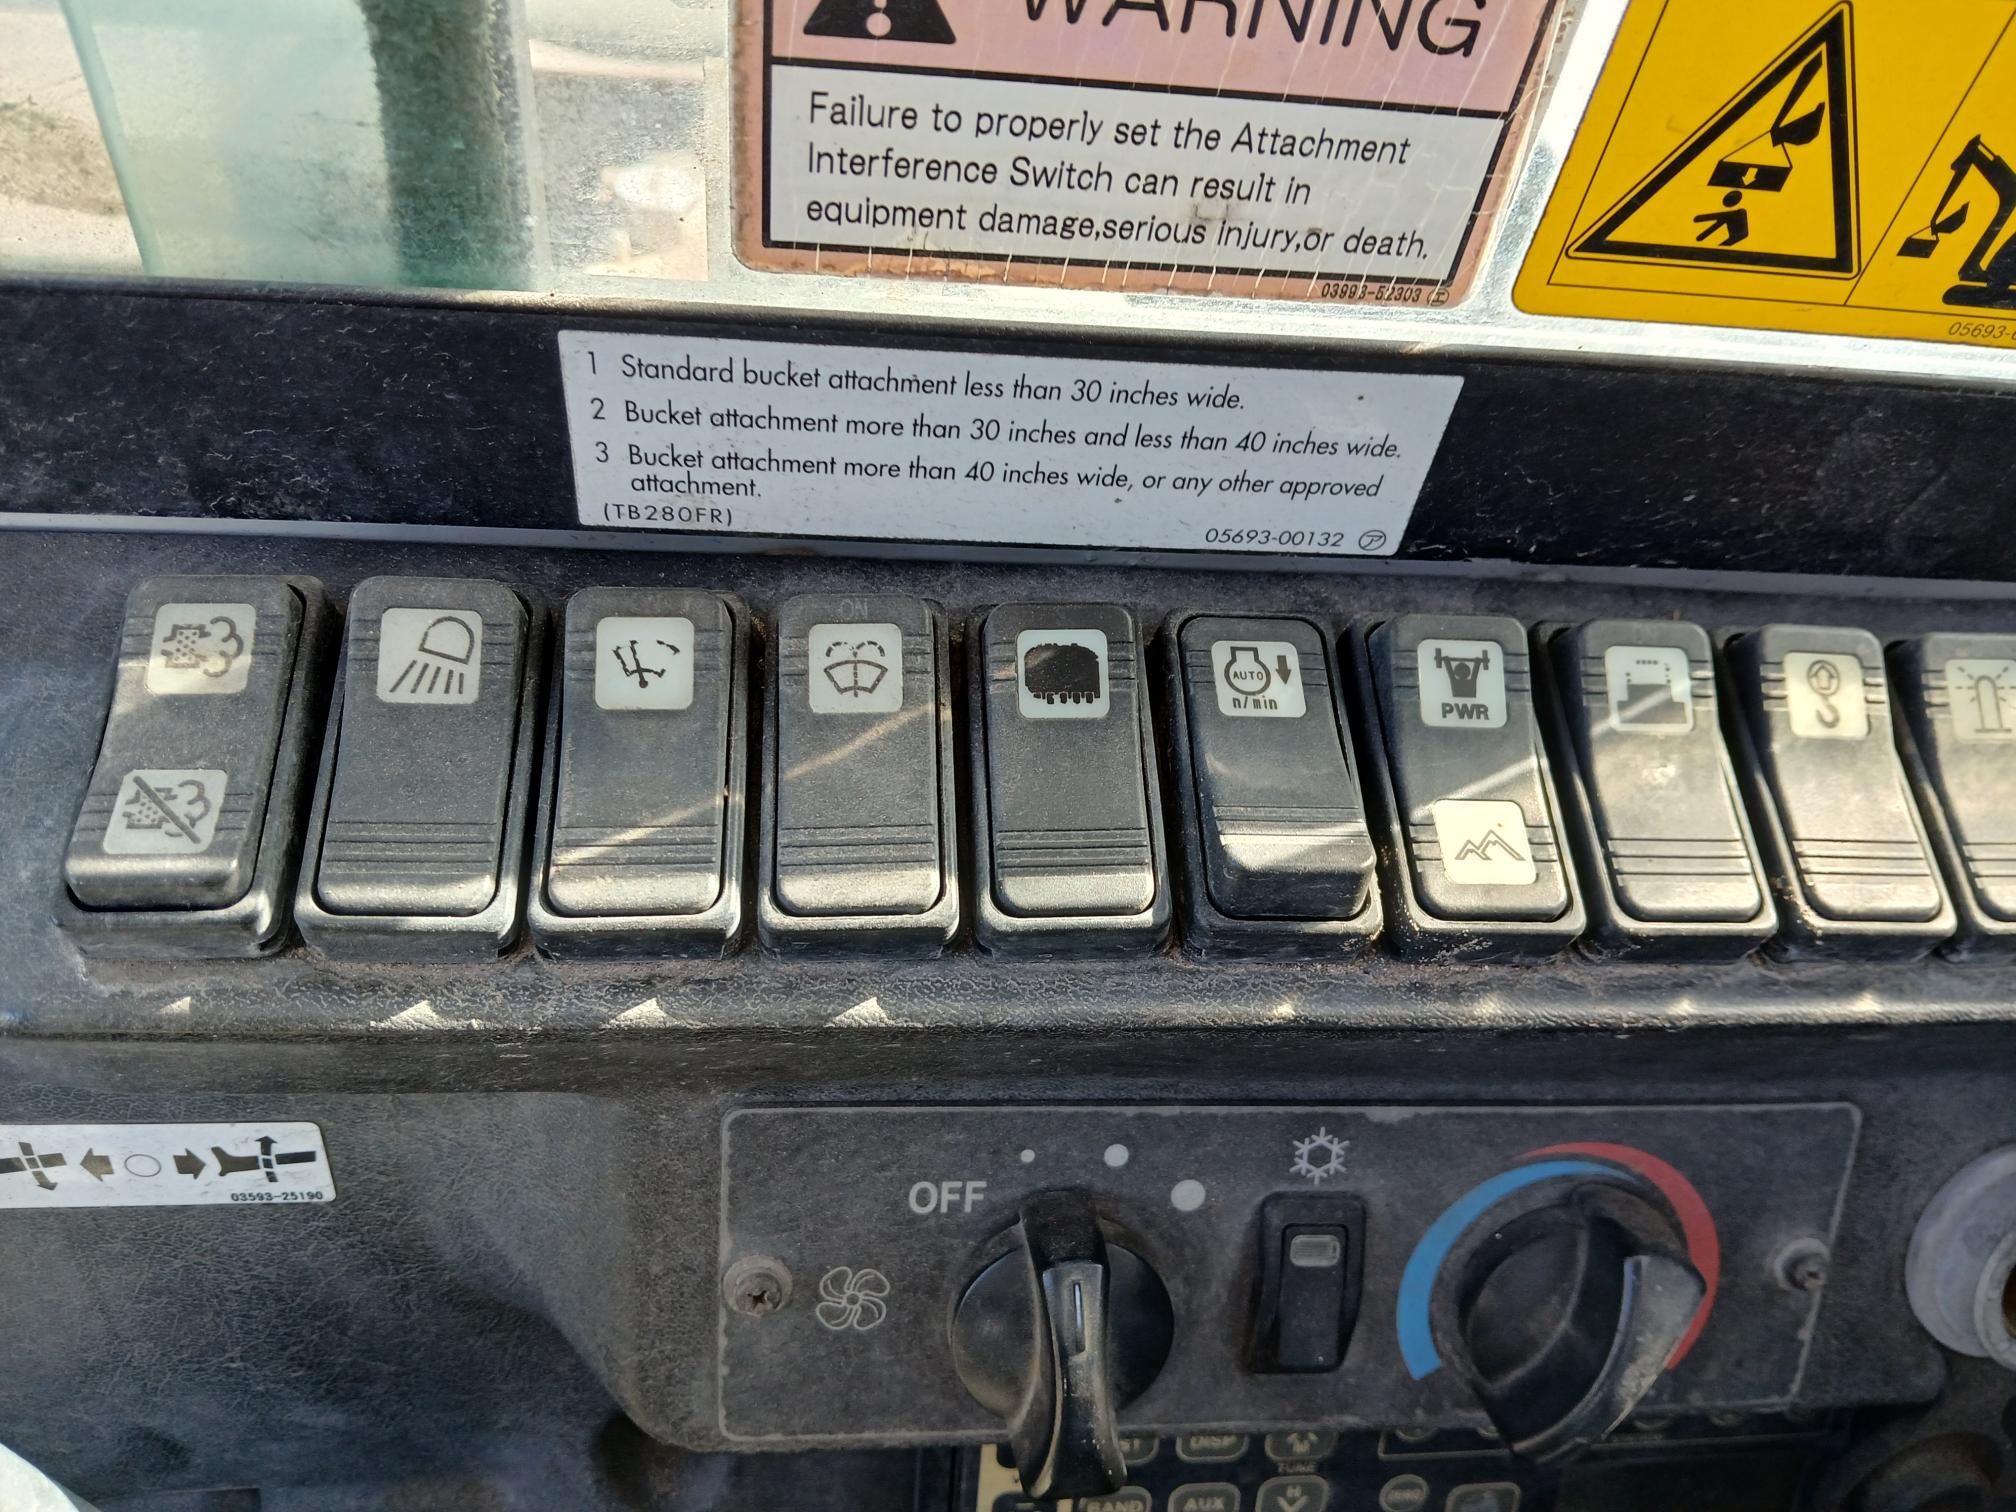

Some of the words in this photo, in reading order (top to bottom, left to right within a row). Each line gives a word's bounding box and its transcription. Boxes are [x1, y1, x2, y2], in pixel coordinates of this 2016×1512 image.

[810, 91, 918, 130] Failure
[932, 104, 962, 133] to
[975, 110, 1103, 145] properly
[1114, 119, 1161, 147] set
[1174, 118, 1221, 151] the
[1231, 122, 1411, 164] Attachment
[809, 142, 997, 184] Interference
[1010, 156, 1112, 192] Switch
[1125, 173, 1178, 196] can
[1190, 172, 1276, 202] result
[1285, 176, 1310, 205] in
[807, 197, 967, 230] equipment
[1344, 227, 1427, 259] death.
[588, 351, 596, 374] 1
[622, 354, 733, 383] Standard
[744, 357, 821, 388] bucket
[829, 366, 957, 395] attachment
[965, 370, 1003, 397] less
[1013, 373, 1061, 400] than
[1071, 379, 1102, 402] 30
[1110, 380, 1178, 406] inches
[1187, 384, 1243, 409] wide.
[591, 397, 605, 420] 2
[625, 399, 702, 426] Bucket
[710, 405, 838, 432] attachment
[847, 420, 903, 436] more
[913, 413, 960, 439] than
[970, 419, 1000, 440] 30
[1009, 419, 1075, 444] inches
[1085, 423, 1129, 446] and
[1135, 423, 1172, 448] less
[1181, 426, 1227, 451] than
[1235, 431, 1266, 452] 40
[1273, 430, 1338, 455] inches
[1347, 434, 1400, 458] wide.
[595, 441, 609, 463] 3
[629, 443, 703, 468] Bucket
[712, 448, 836, 474] attachment
[845, 462, 900, 477] more
[909, 455, 955, 480] than
[965, 461, 994, 481] 40
[1003, 461, 1068, 485] inches
[1077, 464, 1133, 491] wide,
[1143, 476, 1166, 488] or
[1173, 477, 1213, 497] any
[1219, 469, 1274, 492] other
[1280, 474, 1384, 501] approved
[631, 470, 761, 496] attachment.
[604, 503, 731, 526] (TB280FR)
[1206, 528, 1344, 547] 05693-00132
[1233, 671, 1264, 681] AUTO
[1232, 696, 1278, 710] n/min
[1442, 703, 1489, 720] PWR
[230, 1191, 324, 1202] 03593-25190
[908, 1181, 988, 1214] OFF
[1182, 1499, 1225, 1511] AUX
